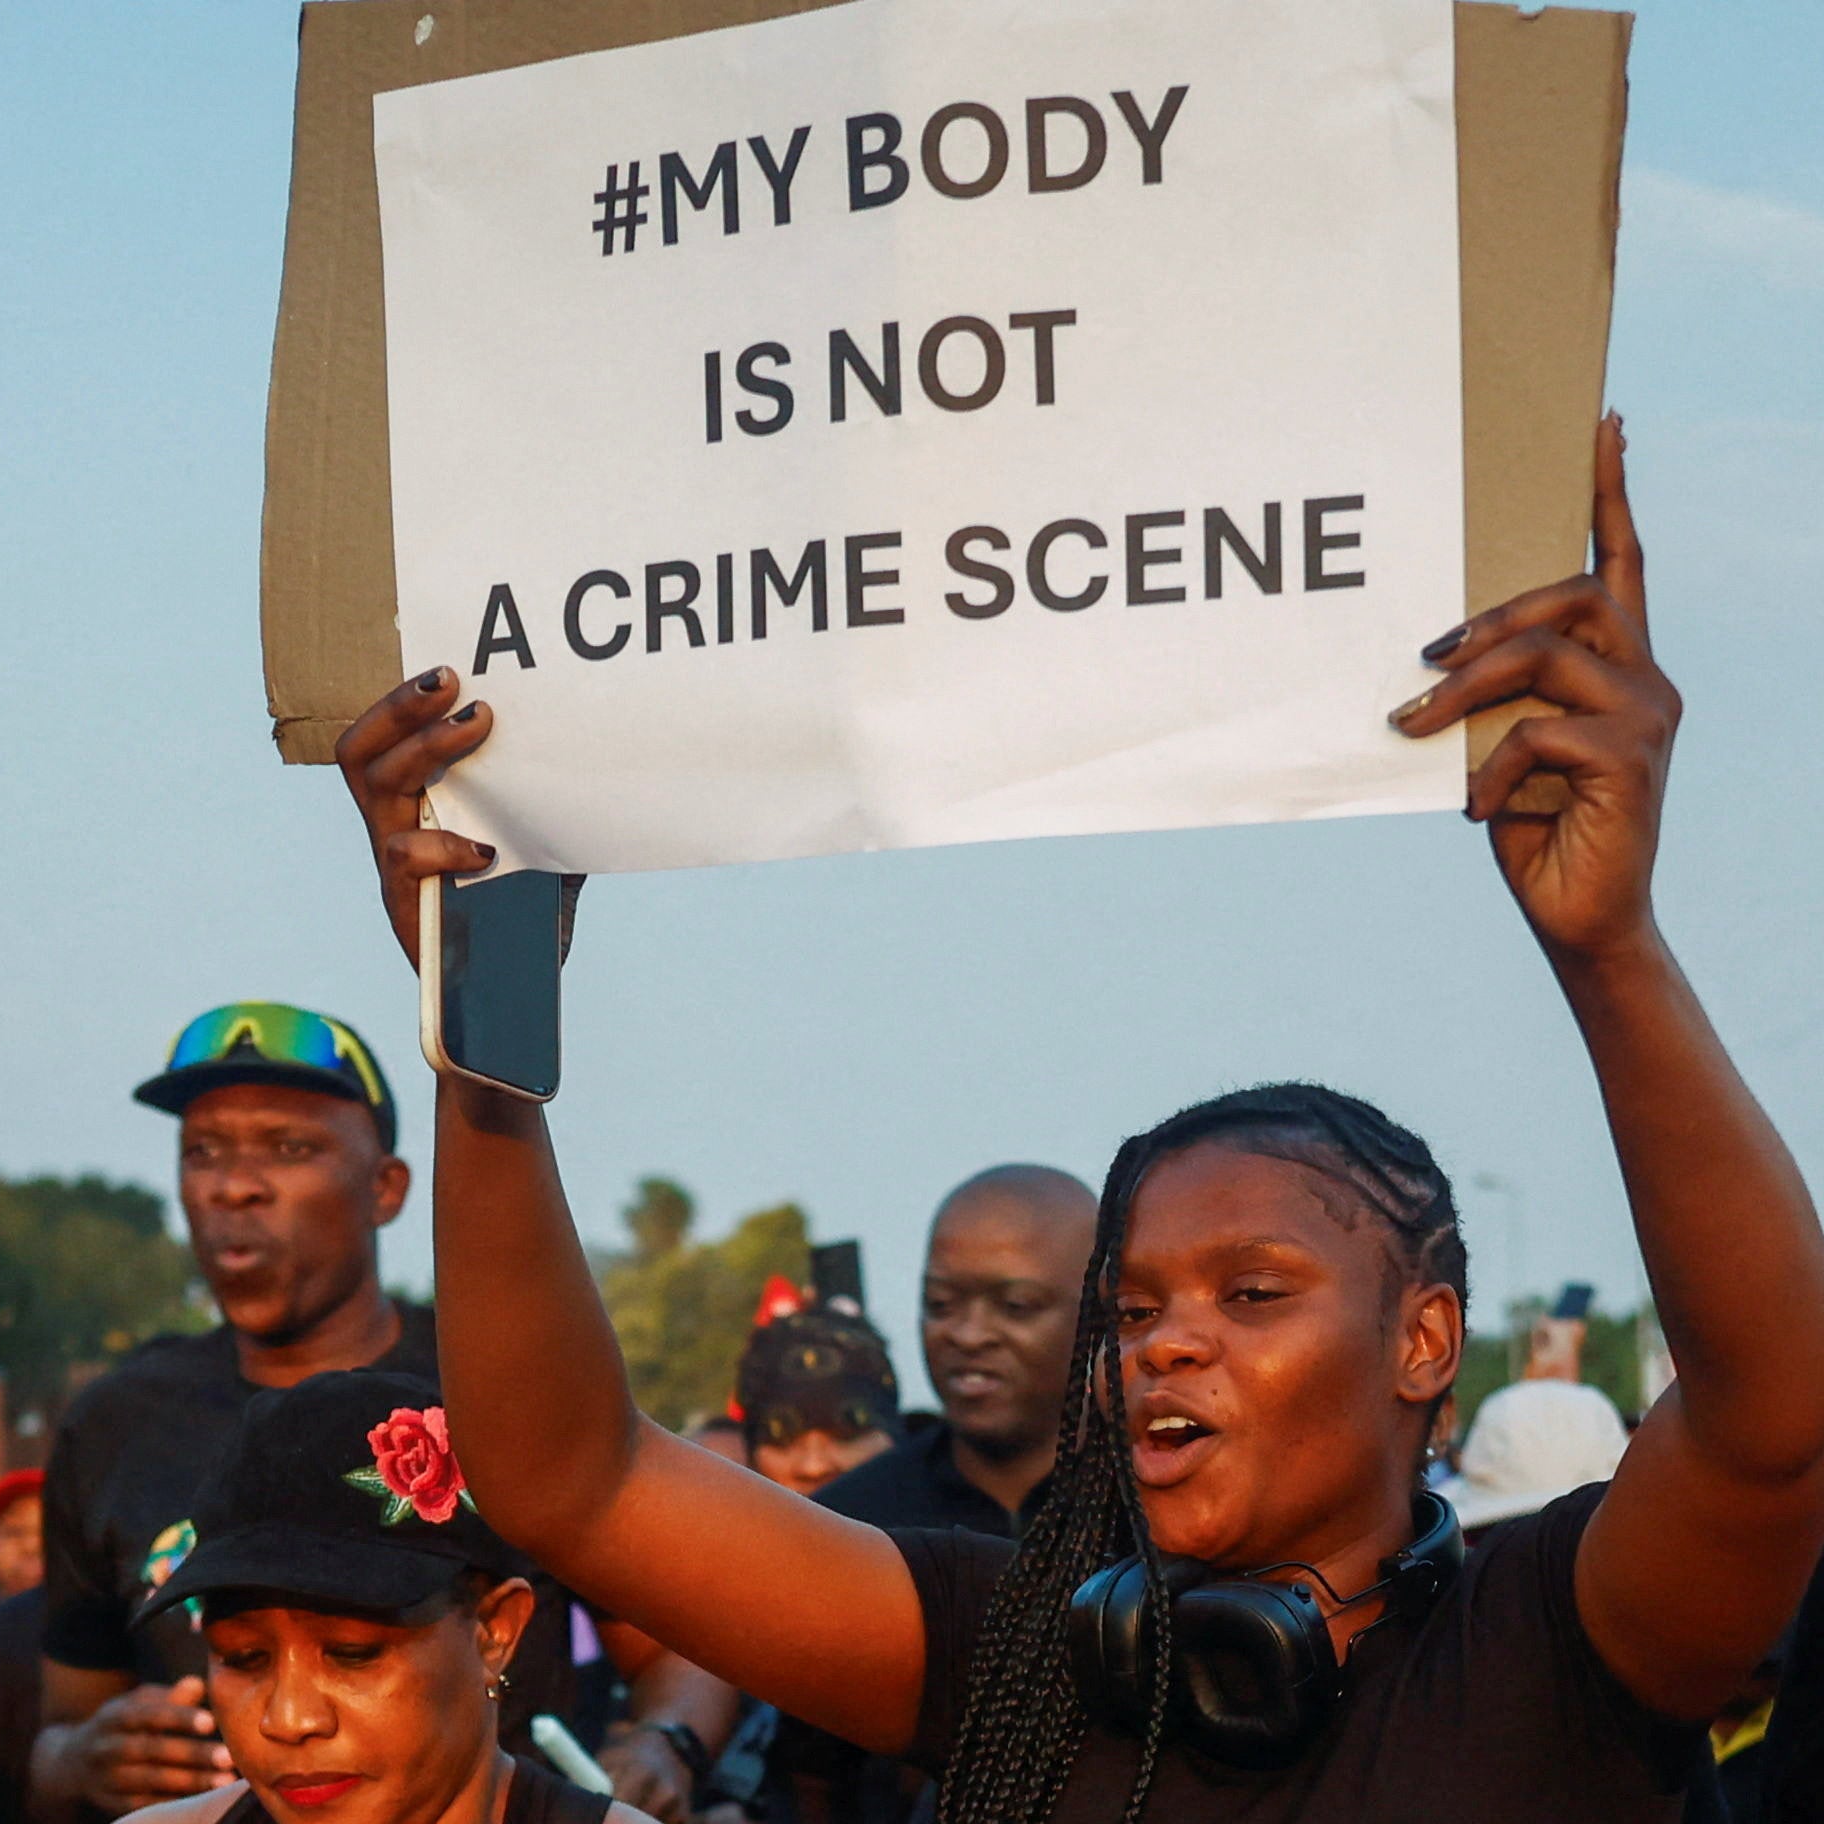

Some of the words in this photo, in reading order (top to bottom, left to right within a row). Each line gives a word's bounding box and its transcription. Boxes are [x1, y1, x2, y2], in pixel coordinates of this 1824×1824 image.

[593, 124, 813, 257] #MY
[844, 84, 1191, 214] BODY
[704, 341, 796, 444] IS
[827, 309, 1078, 424] NOT
[471, 583, 537, 676] A
[563, 531, 906, 661] CRIME
[944, 494, 1366, 621] SCENE
